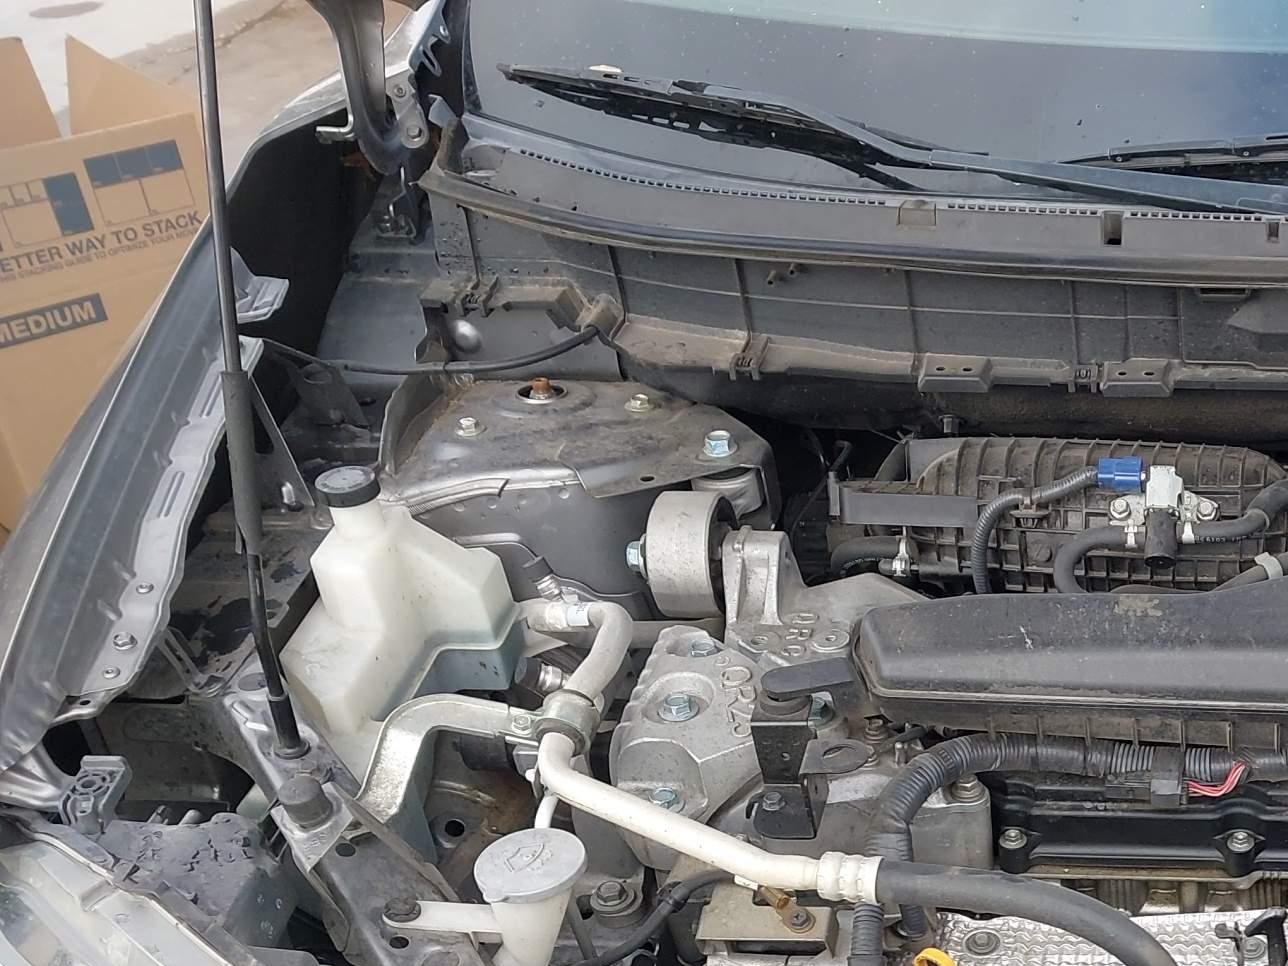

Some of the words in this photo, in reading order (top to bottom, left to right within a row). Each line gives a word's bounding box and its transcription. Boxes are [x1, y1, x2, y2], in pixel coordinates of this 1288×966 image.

[65, 233, 106, 256] WAY
[111, 227, 138, 244] TO
[142, 210, 203, 237] STACK
